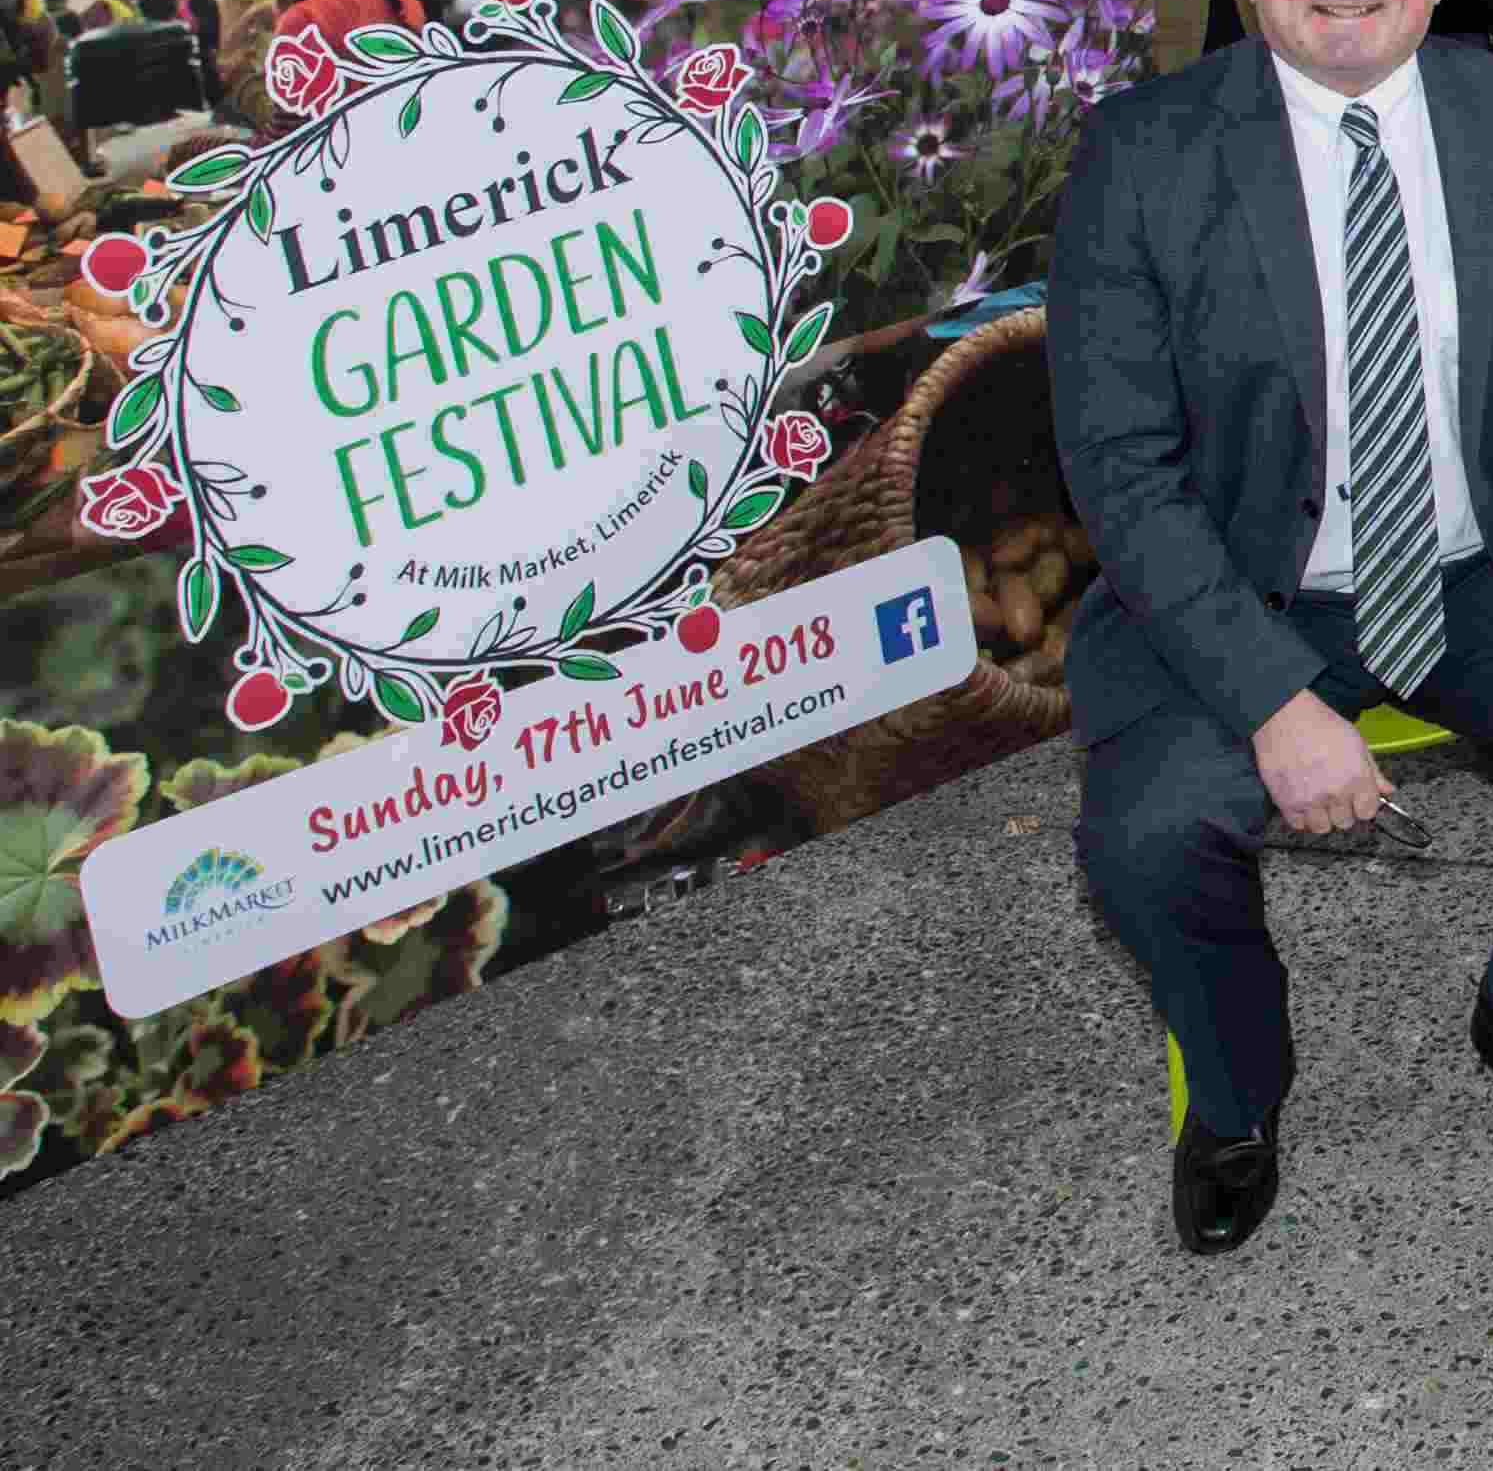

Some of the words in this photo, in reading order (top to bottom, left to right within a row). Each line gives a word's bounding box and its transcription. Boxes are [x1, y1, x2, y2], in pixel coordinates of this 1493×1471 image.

[274, 127, 632, 295] Limerick
[312, 209, 662, 417] GARDEN
[334, 326, 711, 547] FESTIVAL
[398, 559, 428, 585] At
[434, 566, 490, 588] Milk
[500, 535, 596, 585] Market,
[596, 448, 684, 541] Limerick
[309, 760, 503, 853] Sunday,
[514, 703, 612, 769] 17th
[624, 667, 729, 731] June
[740, 616, 834, 685] 2018
[321, 682, 847, 905] www.limerickgardenfestival.com
